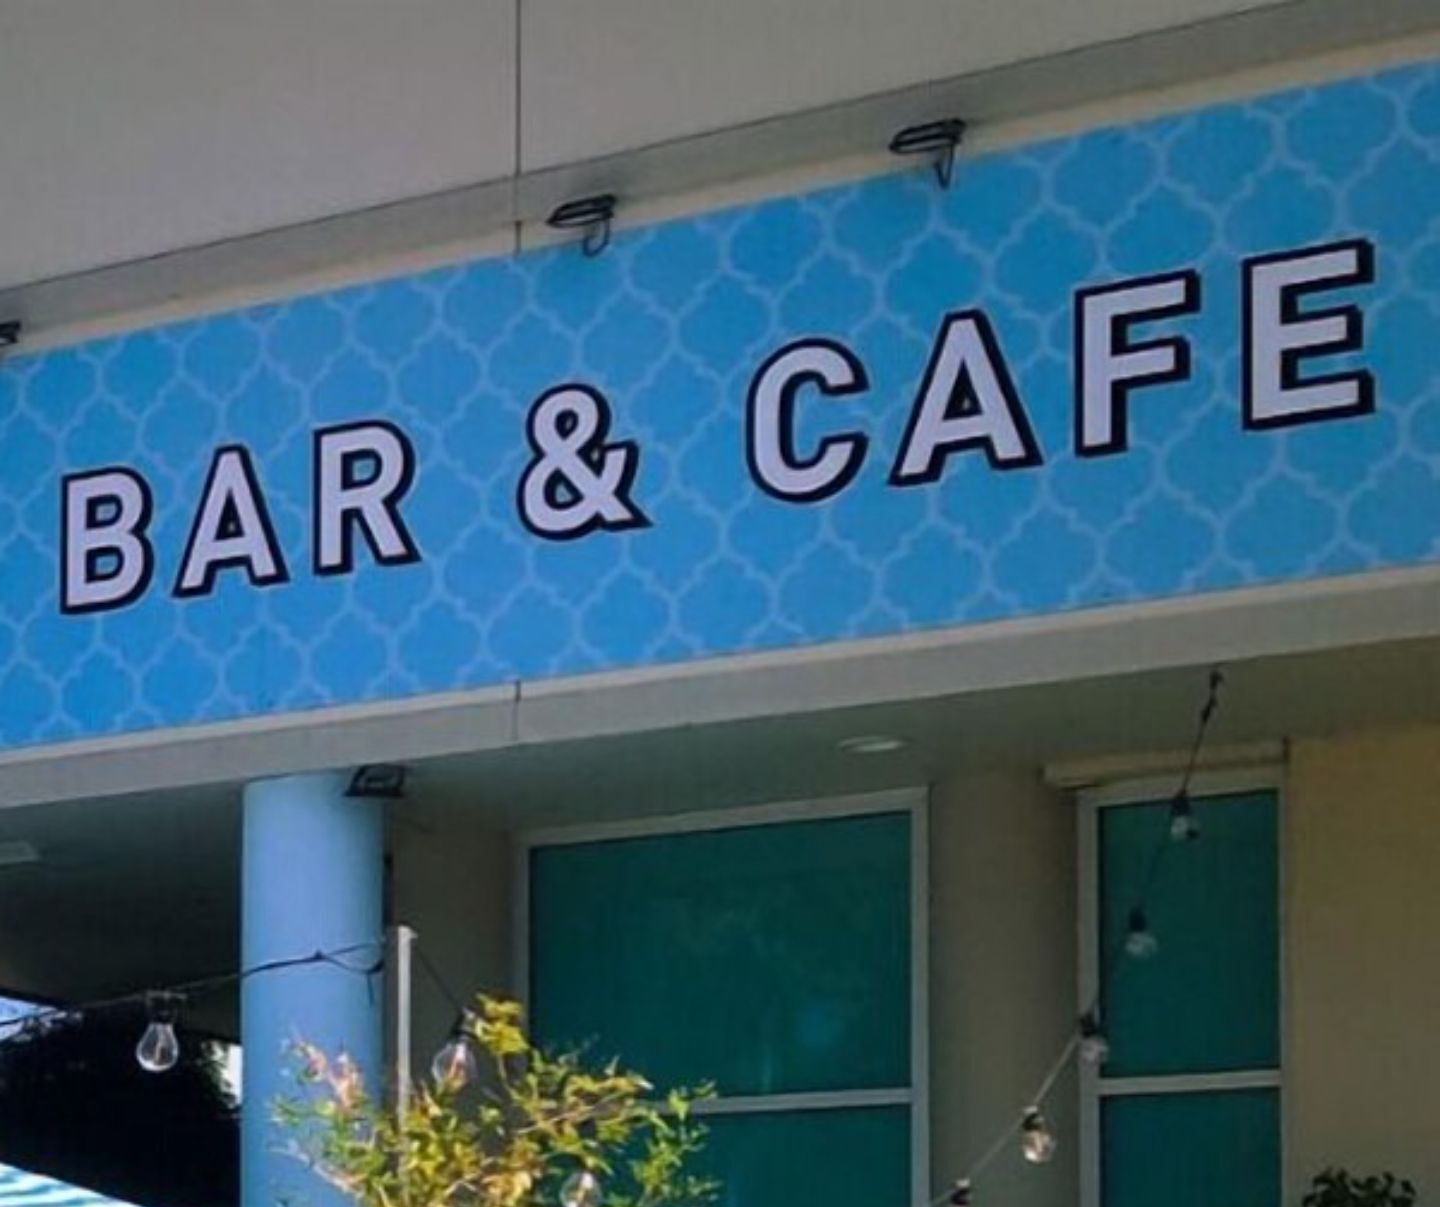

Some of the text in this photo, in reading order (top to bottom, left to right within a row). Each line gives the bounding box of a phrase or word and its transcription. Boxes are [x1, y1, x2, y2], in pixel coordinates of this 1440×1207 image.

[59, 418, 420, 614] BAR
[516, 381, 653, 542] &
[747, 237, 1376, 504] CAFE
